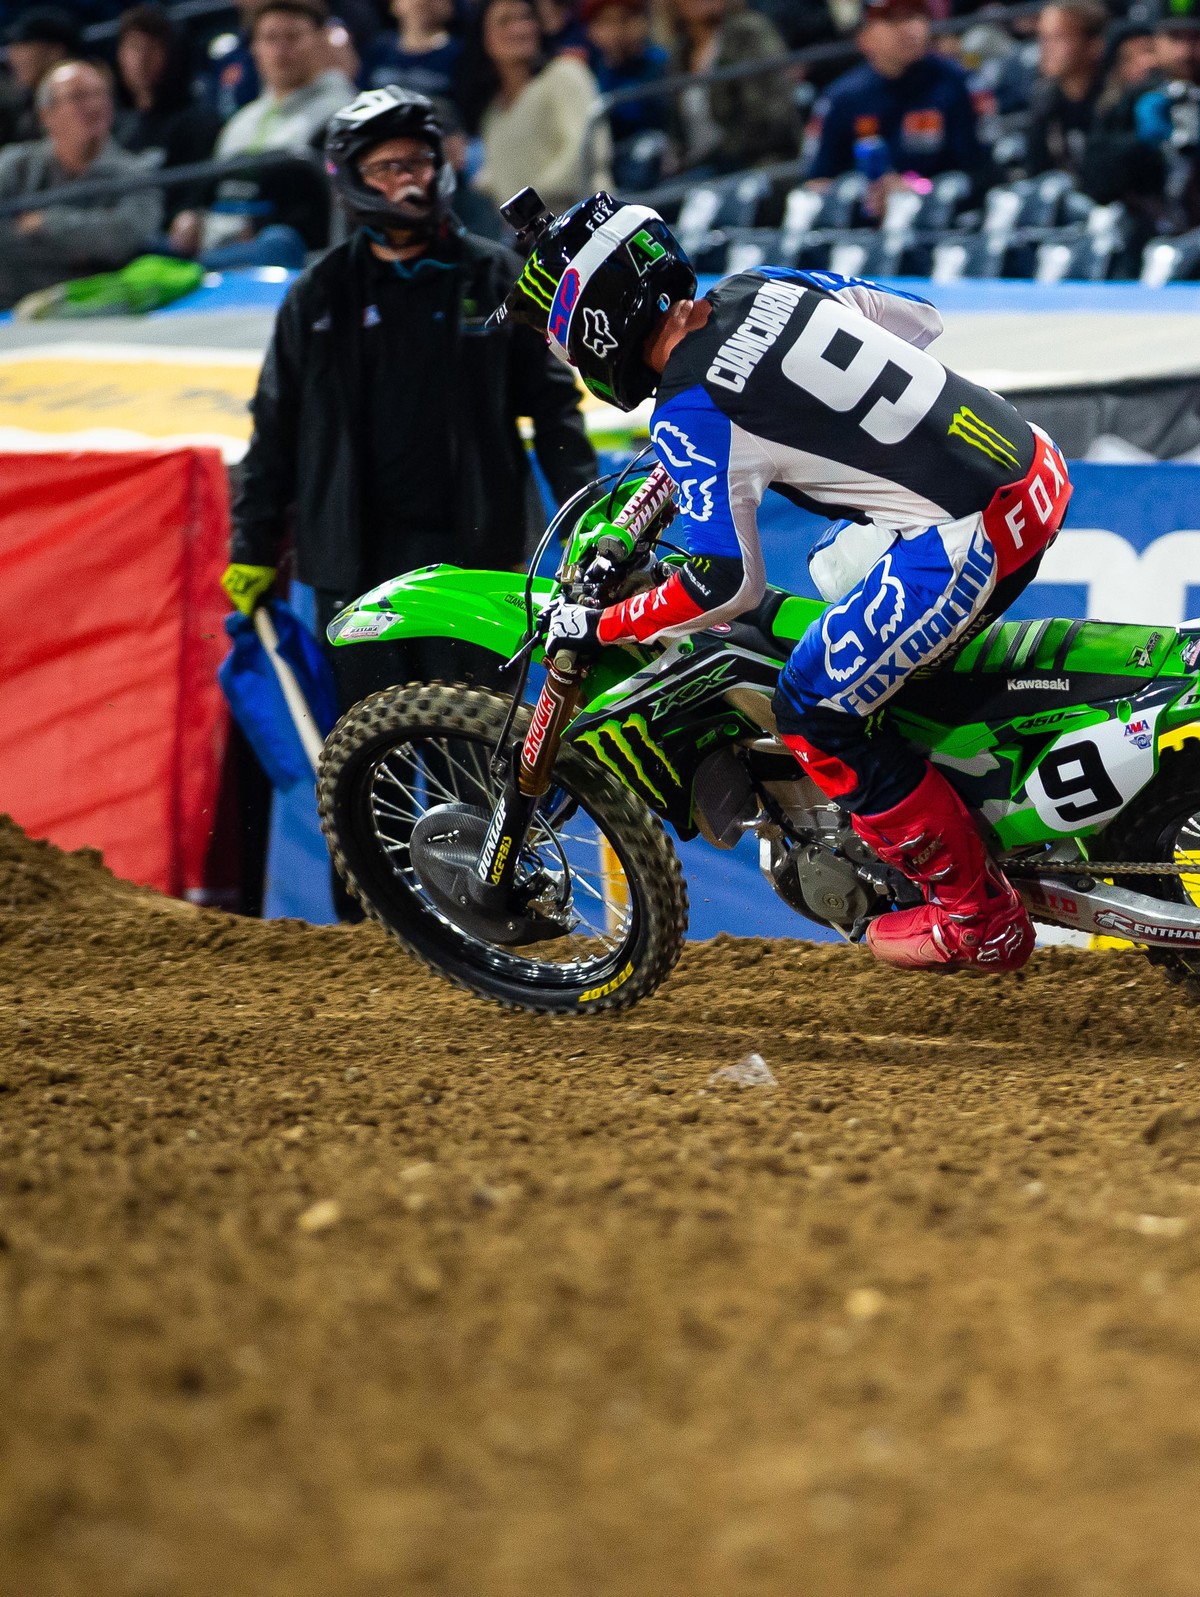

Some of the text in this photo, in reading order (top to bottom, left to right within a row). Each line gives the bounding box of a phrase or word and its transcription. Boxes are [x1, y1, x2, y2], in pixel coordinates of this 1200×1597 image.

[495, 302, 509, 324] FOX
[781, 299, 947, 444] 9
[1003, 449, 1066, 549] FOX
[621, 580, 669, 623] OX
[839, 650, 910, 717] FOX
[1007, 678, 1070, 692] Kawasaki
[523, 687, 557, 767] SHOWA
[1016, 712, 1066, 731] 450
[1124, 719, 1151, 737] AMA
[1037, 739, 1124, 823] 9
[477, 796, 507, 881] DUNLOP
